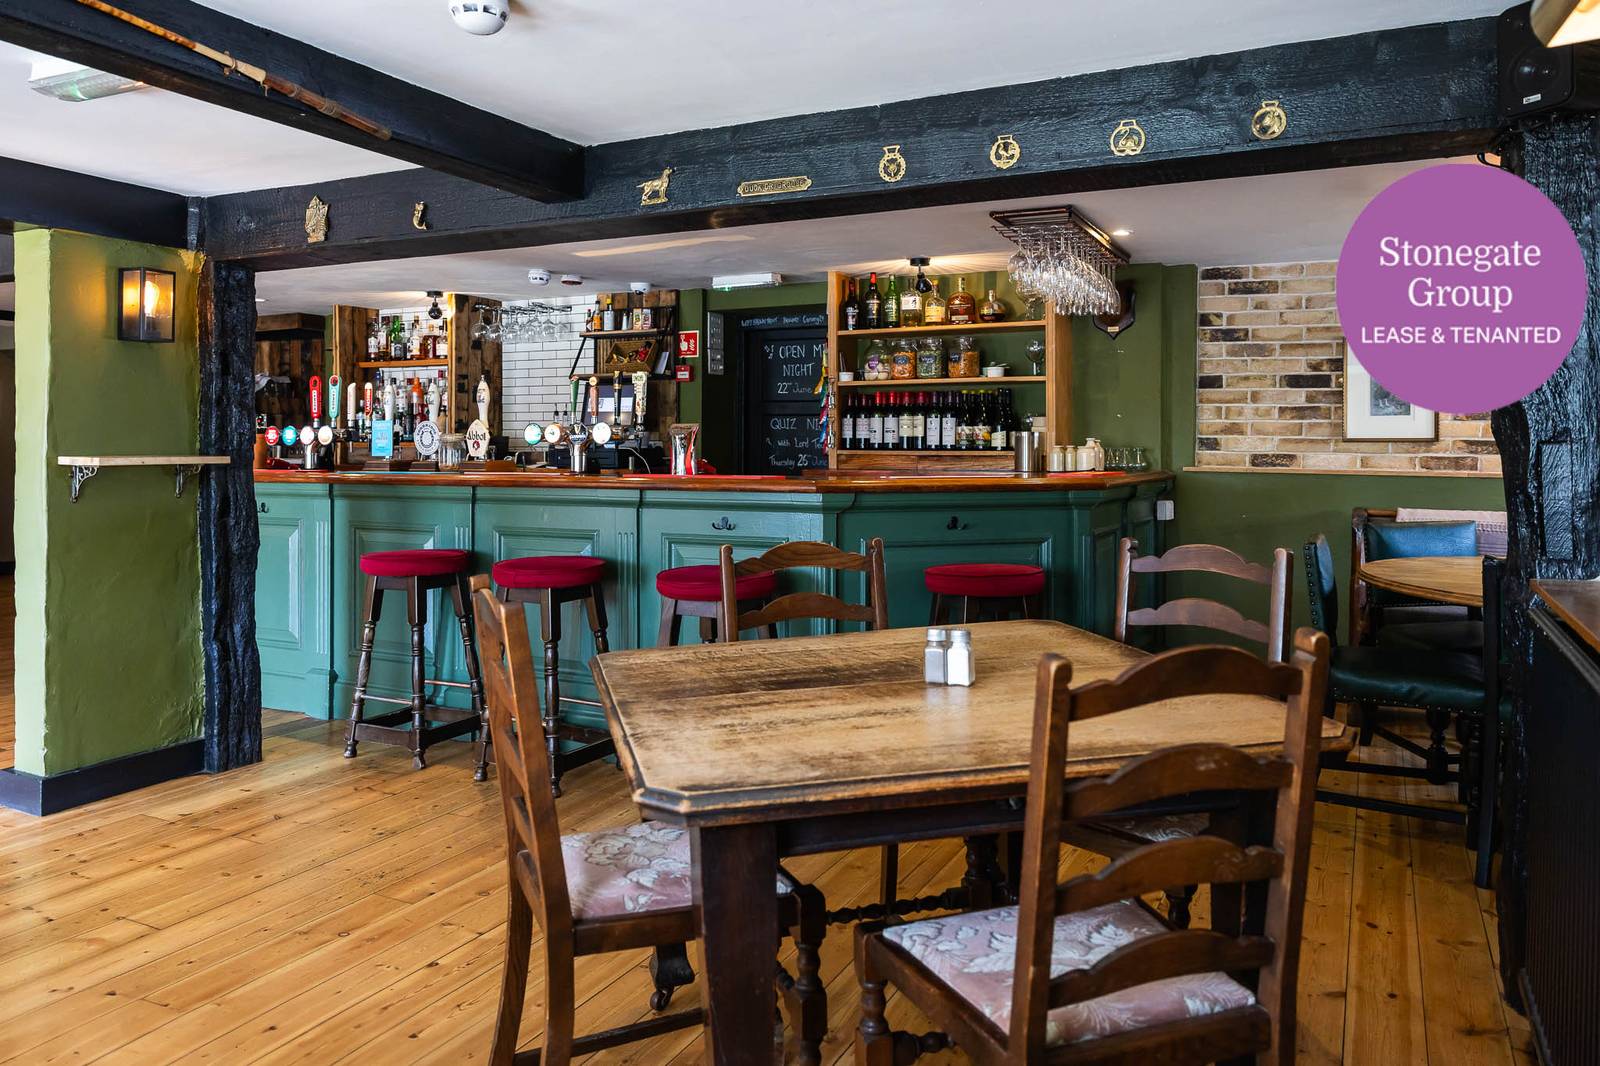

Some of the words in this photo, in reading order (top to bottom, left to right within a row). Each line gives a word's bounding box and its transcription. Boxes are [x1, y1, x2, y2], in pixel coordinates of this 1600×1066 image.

[779, 345, 805, 359] OPEN
[783, 362, 815, 377] NIGHT
[793, 382, 812, 394] June
[770, 417, 796, 430] QUIZ
[806, 417, 821, 430] NI
[467, 430, 487, 441] Abbot
